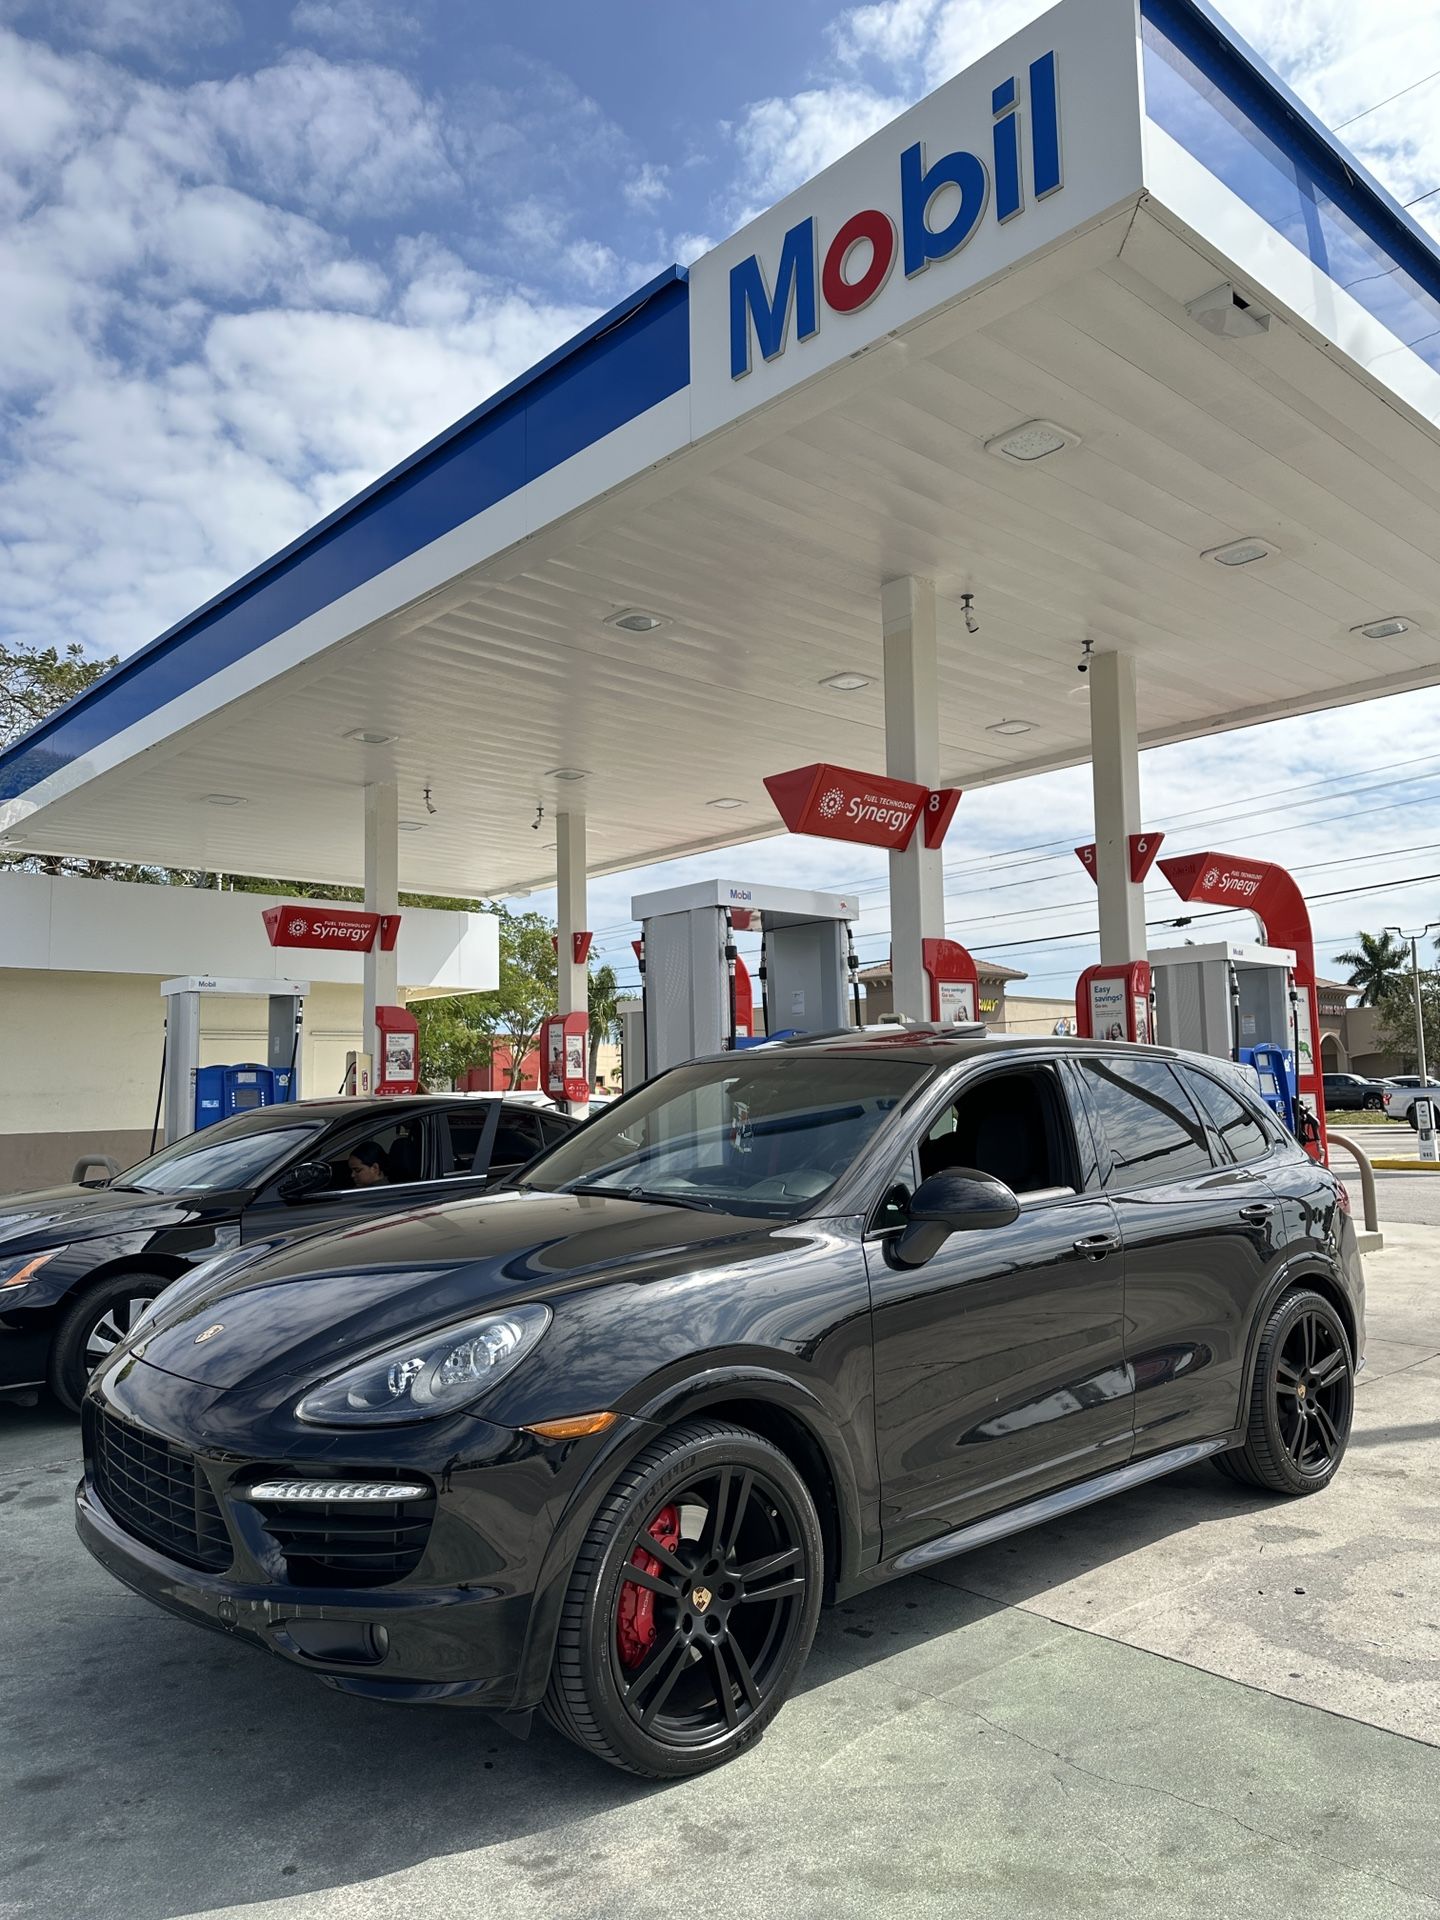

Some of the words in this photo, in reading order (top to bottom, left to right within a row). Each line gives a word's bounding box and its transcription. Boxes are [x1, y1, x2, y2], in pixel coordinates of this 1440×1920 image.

[730, 50, 1064, 381] Mobil
[863, 794, 878, 804] FUEL
[879, 797, 917, 810] TECHNOLOGY
[929, 794, 940, 811] 8
[846, 797, 912, 831] Synergy
[1137, 838, 1148, 853] 6
[1084, 848, 1093, 864] 5
[1219, 873, 1260, 896] Synergy
[730, 889, 752, 901] Mobil
[382, 919, 388, 928] 4
[312, 923, 369, 941] Synergy
[576, 934, 582, 945] 2
[1094, 986, 1111, 995] Easy
[1094, 994, 1123, 1003] savings?
